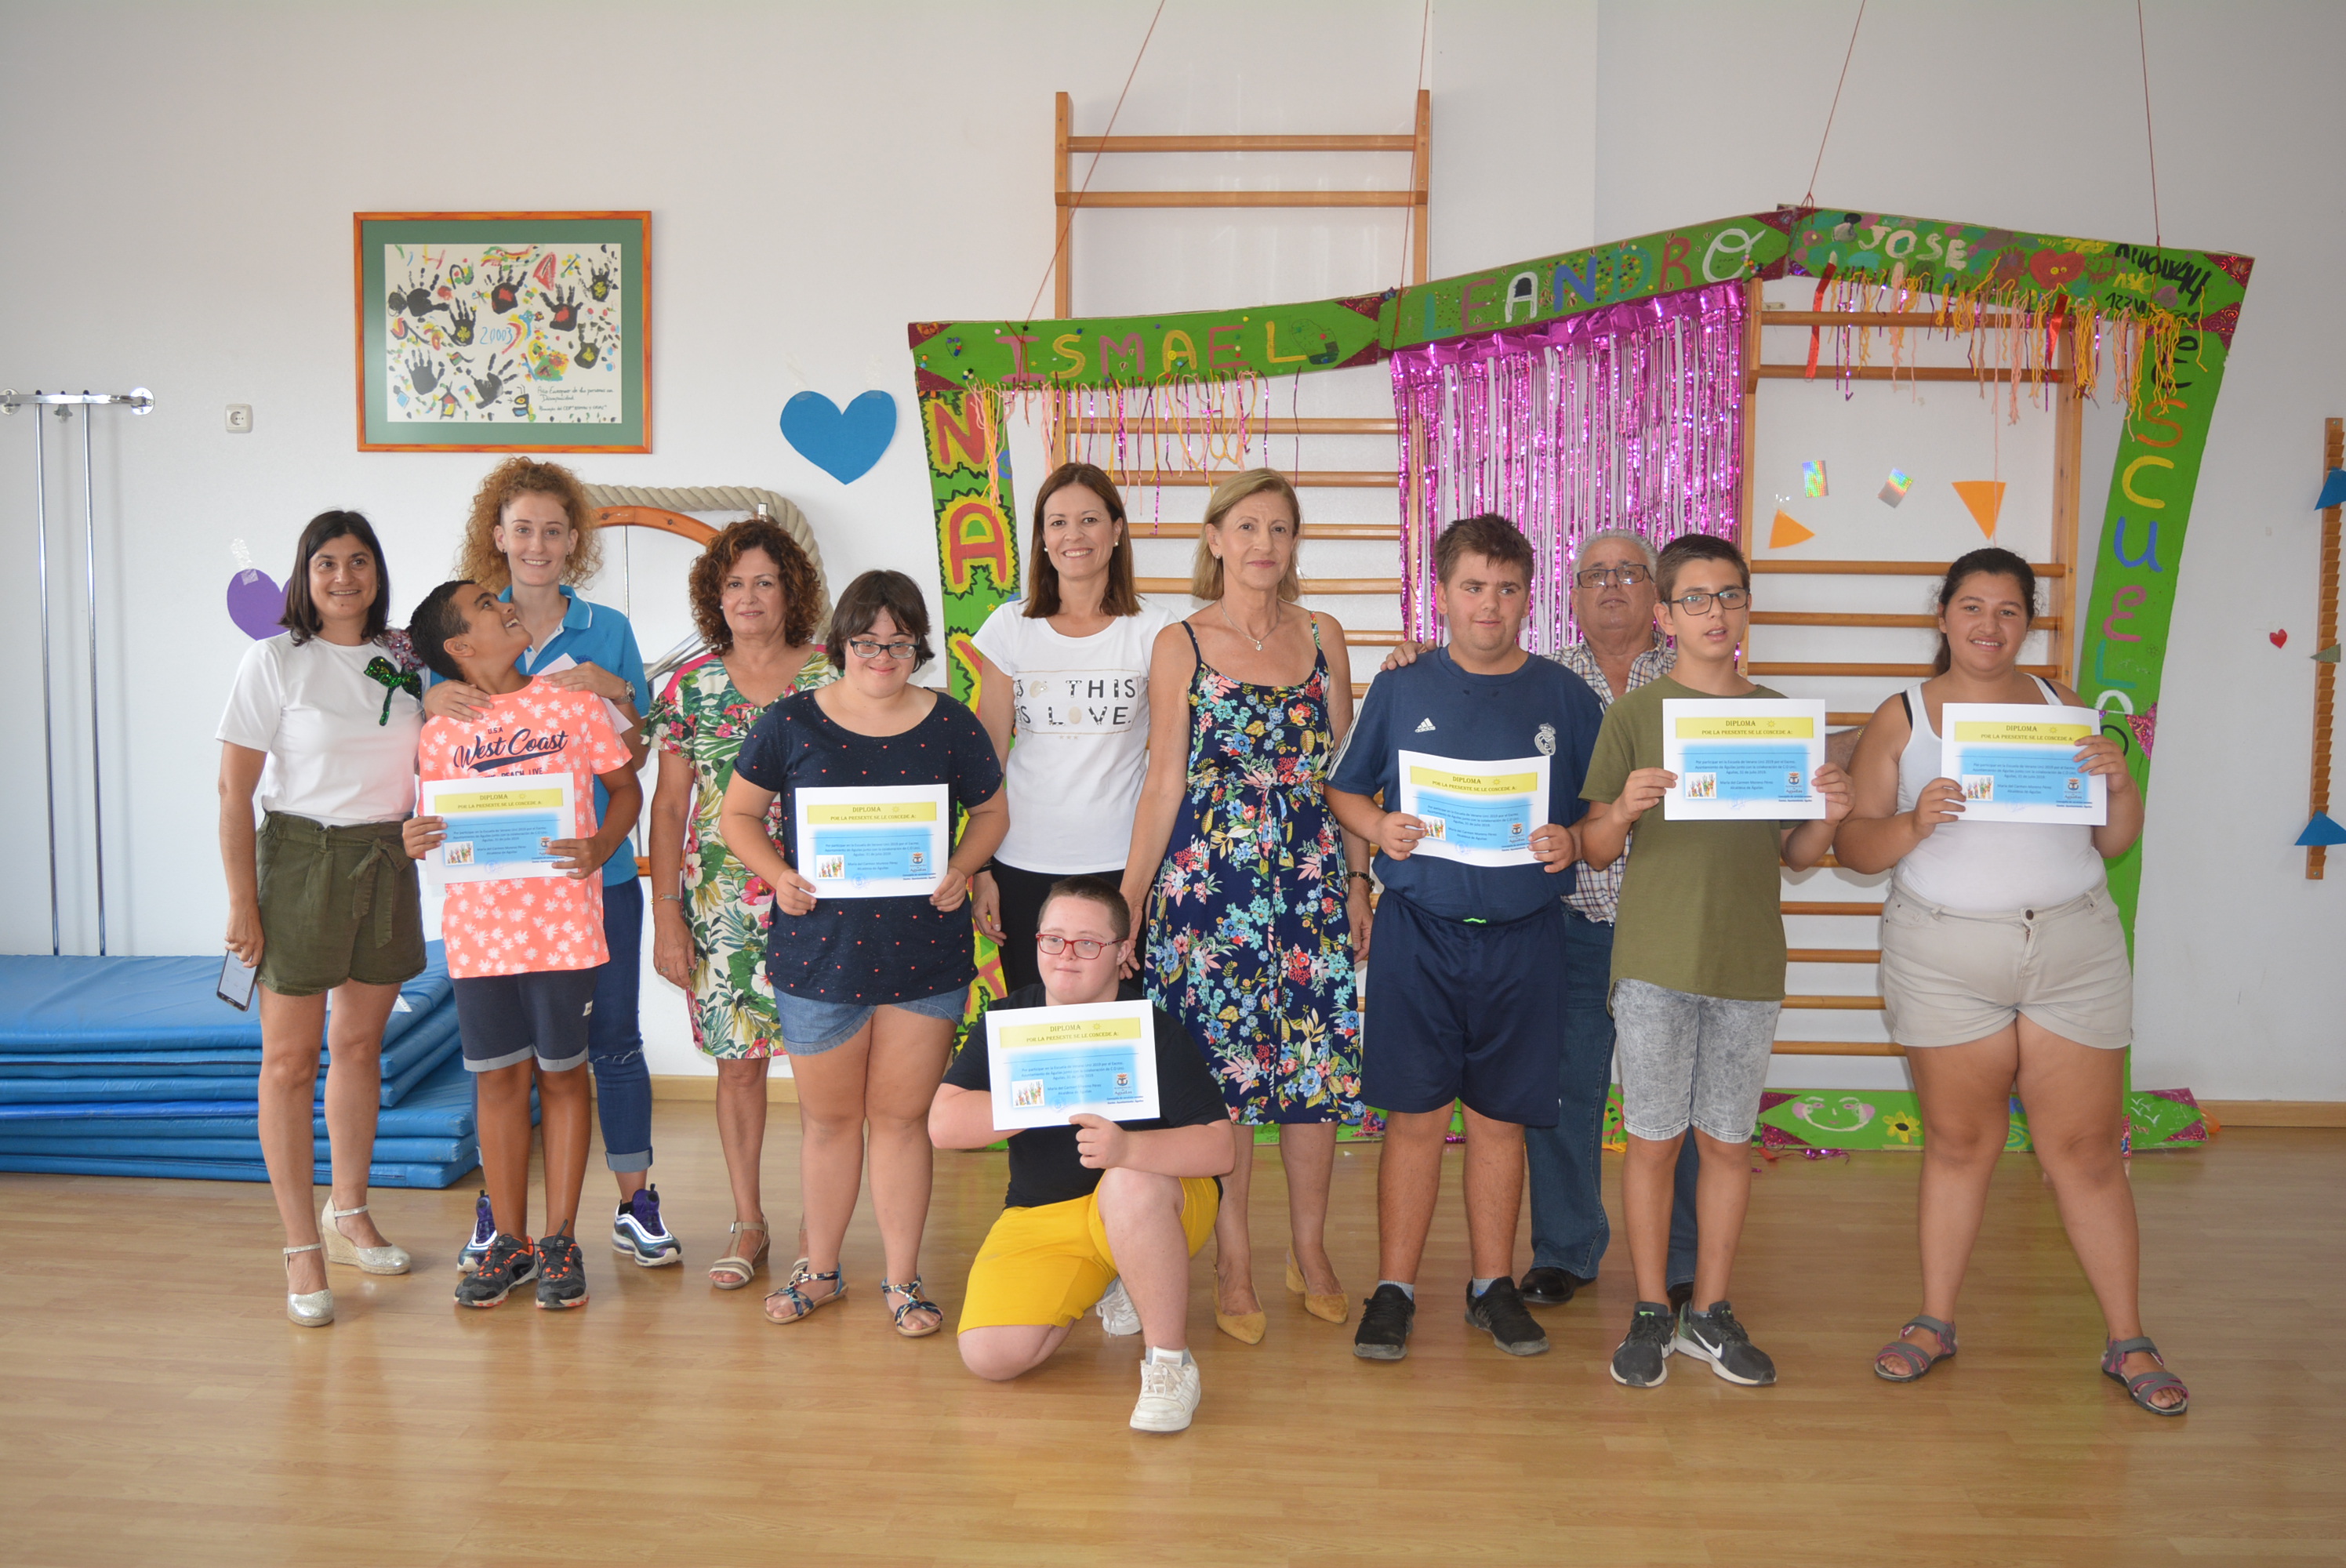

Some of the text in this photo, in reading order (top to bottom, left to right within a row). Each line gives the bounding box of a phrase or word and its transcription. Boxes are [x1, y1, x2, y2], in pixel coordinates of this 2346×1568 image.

[1858, 225, 1967, 270] JOSE
[1422, 227, 1767, 340] LEANDRO
[995, 321, 1307, 383] ISMAEL
[1066, 679, 1136, 699] THIS
[1048, 706, 1131, 725] LOVE.
[453, 728, 569, 768] West Coast
[1050, 1024, 1081, 1033] DIPLOMA
